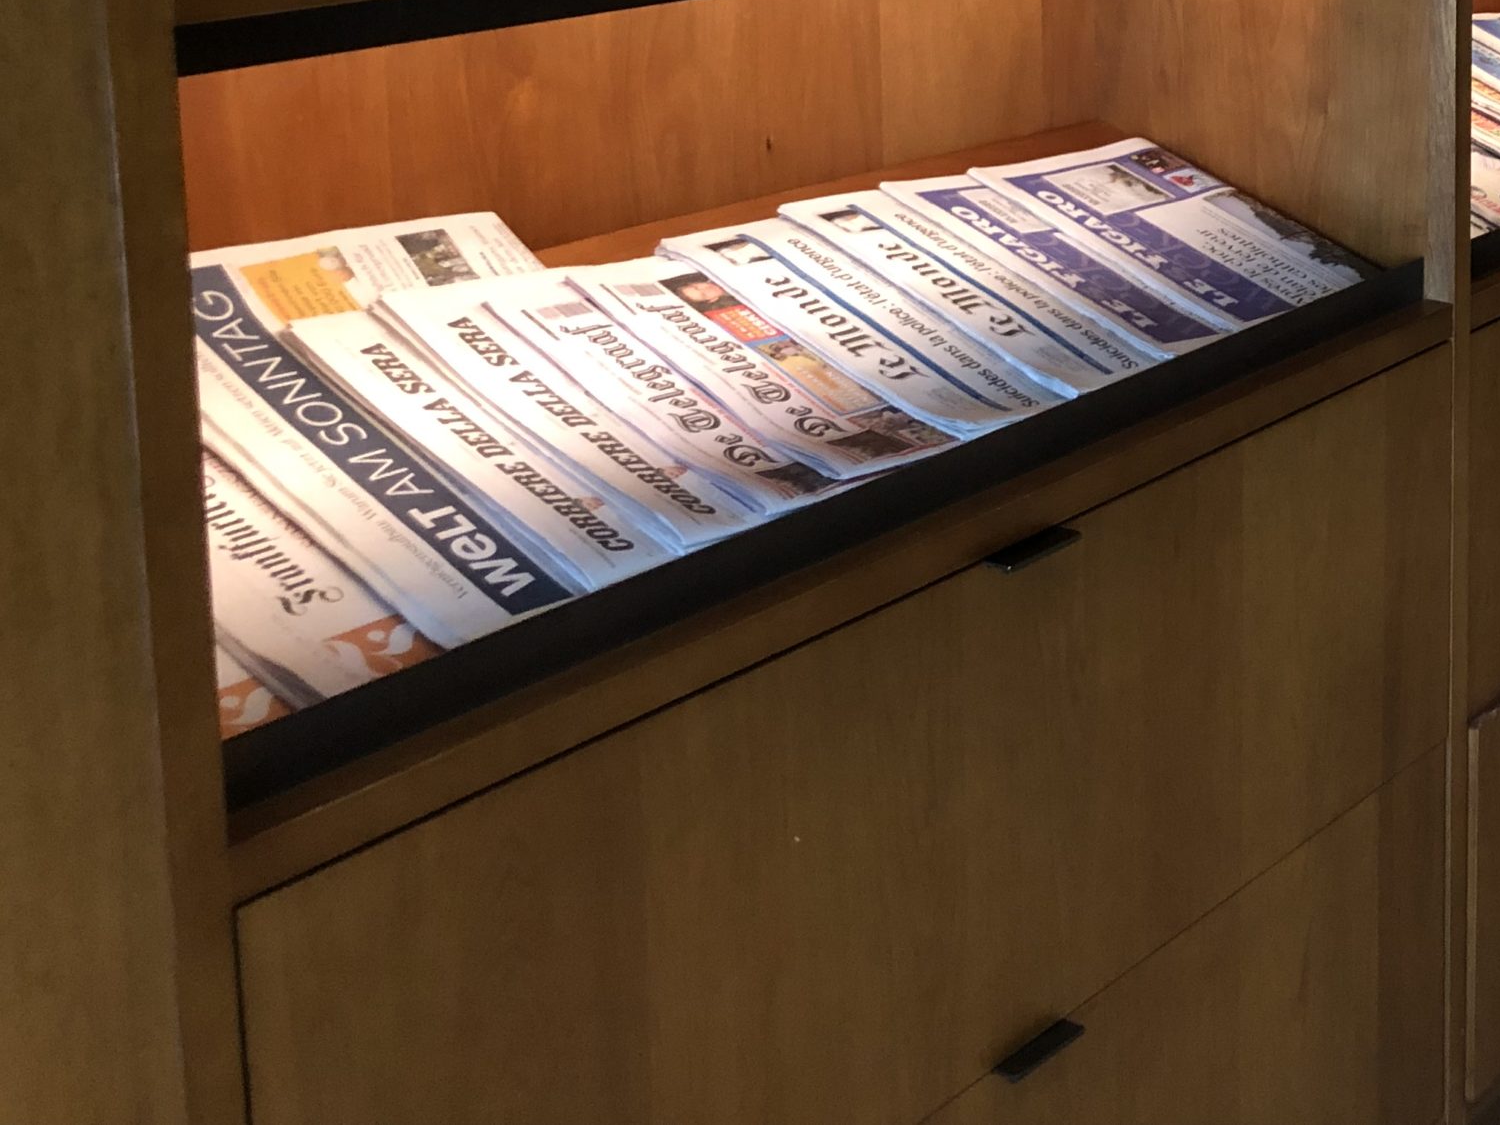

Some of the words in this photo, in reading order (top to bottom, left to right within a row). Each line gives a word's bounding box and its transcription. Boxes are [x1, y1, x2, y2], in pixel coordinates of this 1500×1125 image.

[950, 206, 1086, 287] FIGARO
[1036, 191, 1169, 269] FIGARO
[785, 238, 855, 277] d'urgence
[876, 243, 994, 313] Monde
[1032, 299, 1050, 307] la
[1097, 298, 1160, 327] LE
[1181, 278, 1240, 305] LE
[761, 275, 891, 357] Monde
[986, 314, 1033, 337] Le
[1047, 308, 1083, 327] dans
[445, 316, 518, 366] SERA
[636, 303, 787, 404] Telegraaf
[929, 335, 948, 346] la
[943, 345, 983, 368] dans
[1078, 329, 1139, 367] Suicides
[191, 290, 368, 445] SONNTAG
[358, 342, 434, 394] SERA
[560, 324, 717, 434] Telegraaf
[875, 354, 928, 379] Le
[974, 368, 1040, 406] Suicides
[508, 369, 597, 427] DELLA
[784, 406, 846, 437] De
[422, 397, 515, 458] DELLA
[715, 433, 777, 467] De
[347, 448, 434, 496] AM
[578, 430, 716, 512] CORRIERE
[493, 459, 633, 550] CORRIERE
